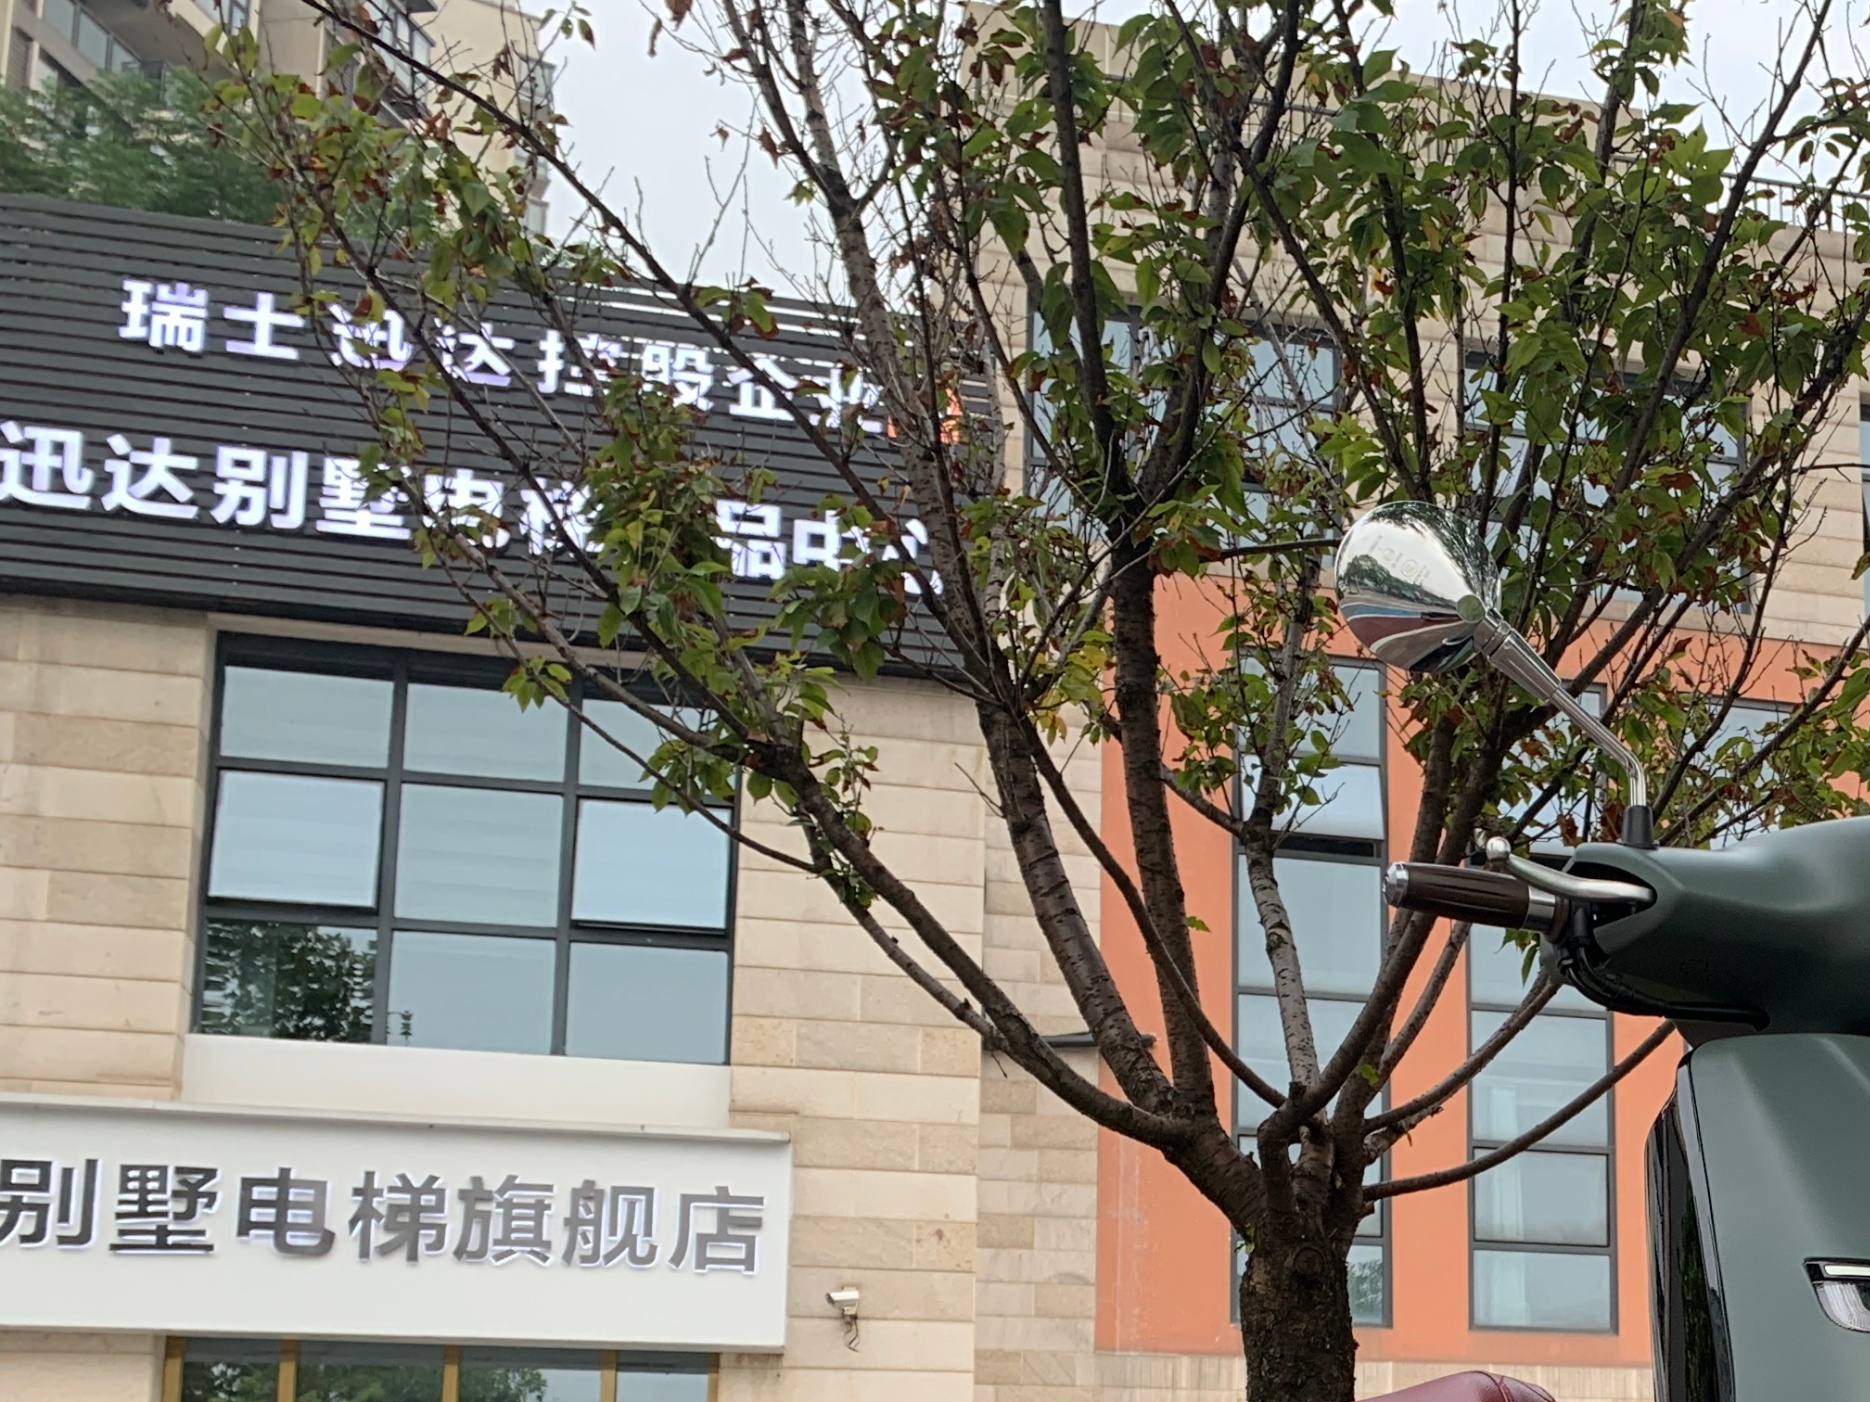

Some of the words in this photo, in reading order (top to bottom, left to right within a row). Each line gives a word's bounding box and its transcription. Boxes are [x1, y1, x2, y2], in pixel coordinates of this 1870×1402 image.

[0, 1157, 765, 1276] 别墅电梯旗舰店
